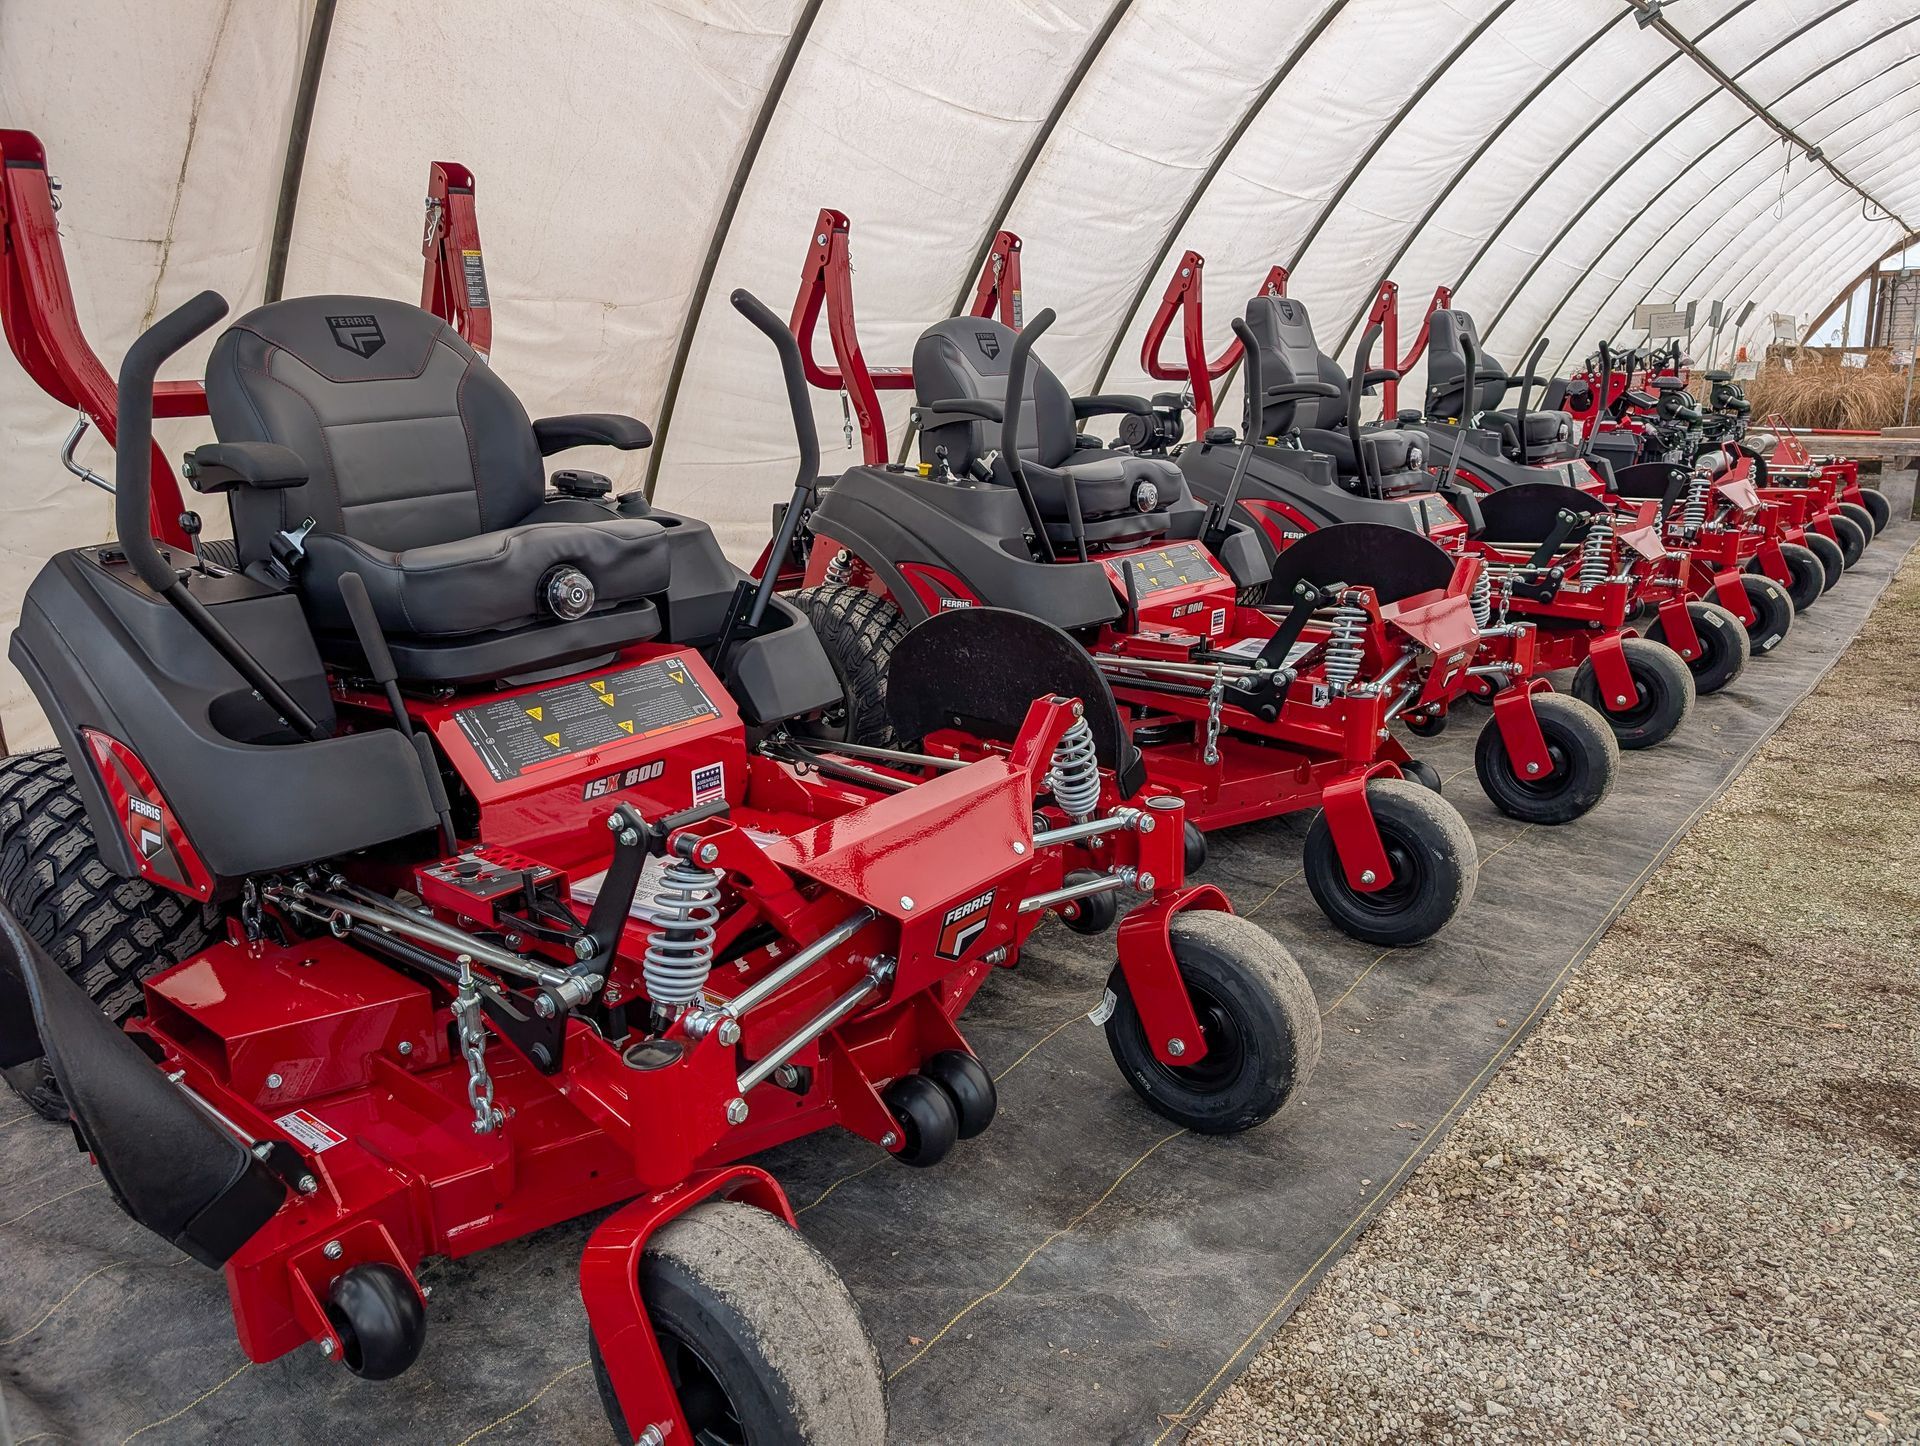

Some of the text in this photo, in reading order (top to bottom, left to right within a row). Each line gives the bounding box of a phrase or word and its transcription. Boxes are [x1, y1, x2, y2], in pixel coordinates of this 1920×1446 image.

[330, 317, 374, 326] FERRIS
[942, 599, 971, 608] FERRIS
[1187, 602, 1203, 614] 800
[584, 761, 664, 800] ISX 800
[130, 798, 161, 821] FERRIS
[945, 891, 994, 926] FERRIS
